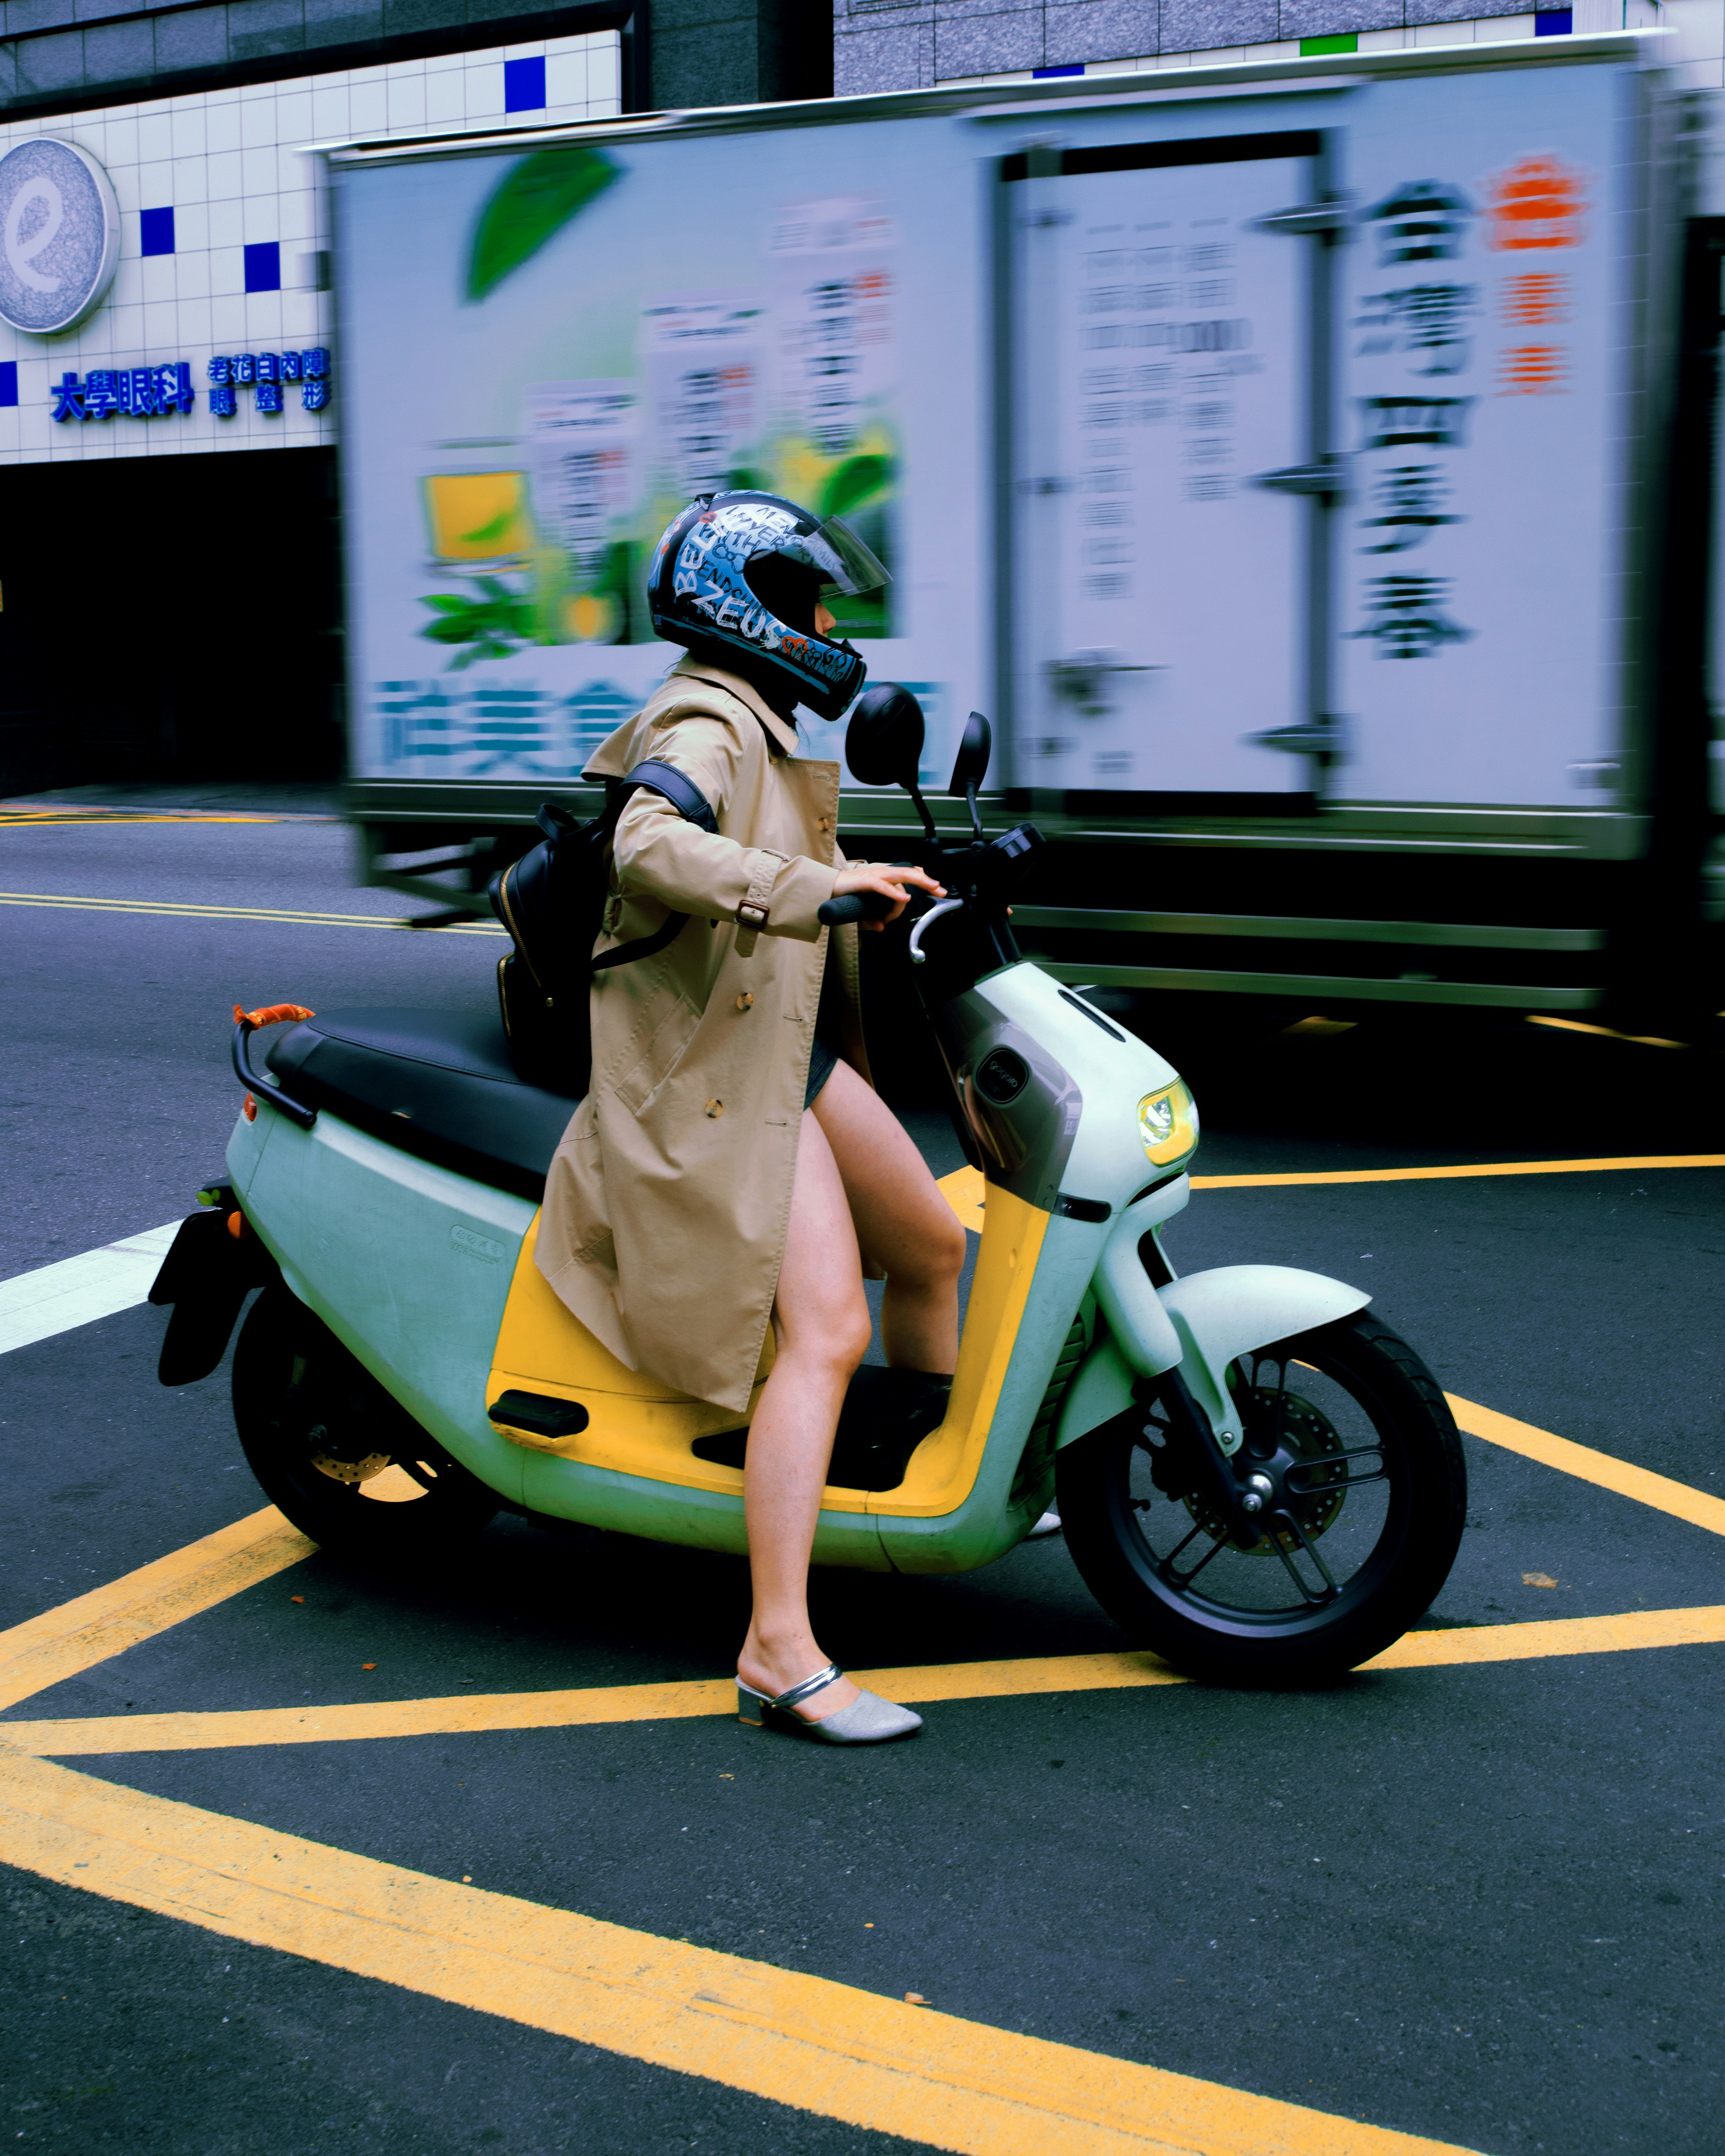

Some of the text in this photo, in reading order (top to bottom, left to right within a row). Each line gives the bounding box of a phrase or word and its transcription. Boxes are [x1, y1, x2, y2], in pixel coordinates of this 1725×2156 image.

[50, 362, 194, 423] 大學眼科
[691, 579, 786, 649] ZEUS
[989, 1061, 1018, 1087] gogoro
